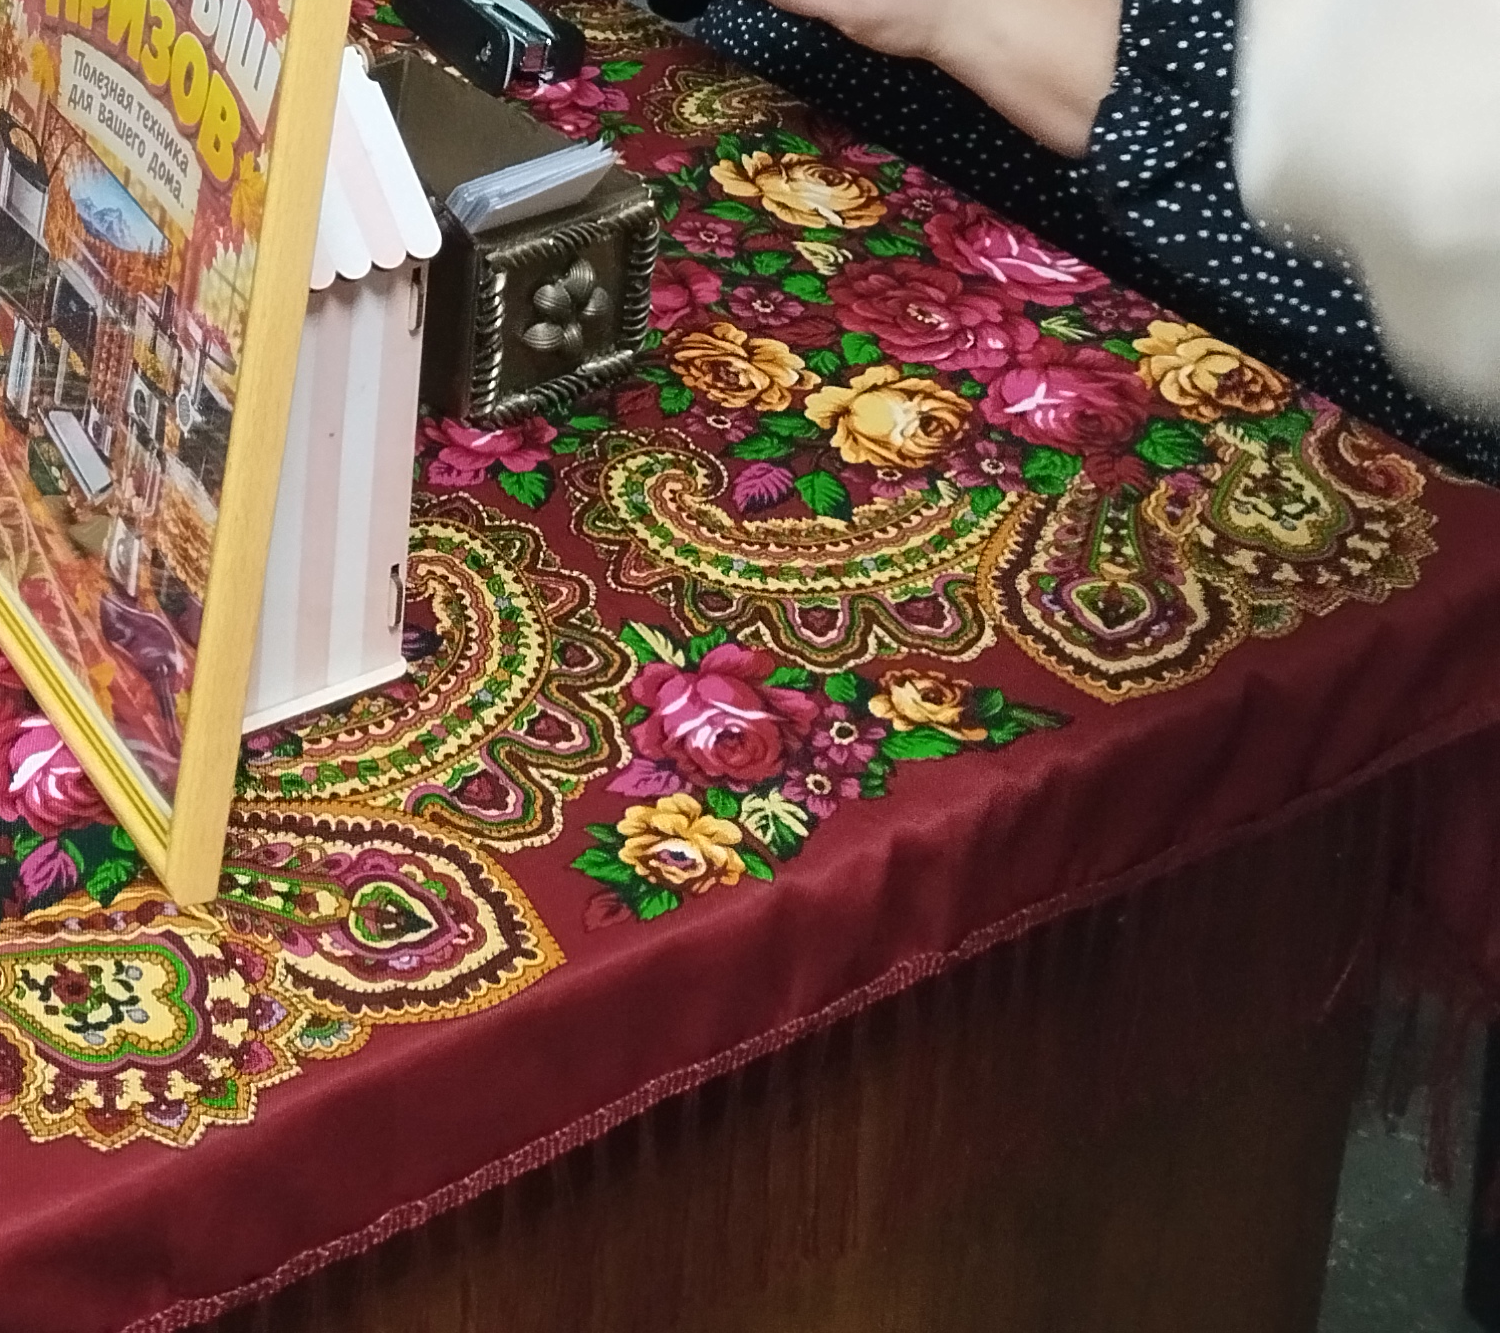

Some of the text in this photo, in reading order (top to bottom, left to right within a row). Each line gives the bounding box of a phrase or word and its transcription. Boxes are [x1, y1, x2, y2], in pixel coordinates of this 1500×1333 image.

[66, 83, 186, 211] для вашего дома.
[73, 49, 190, 178] Полезная техника
